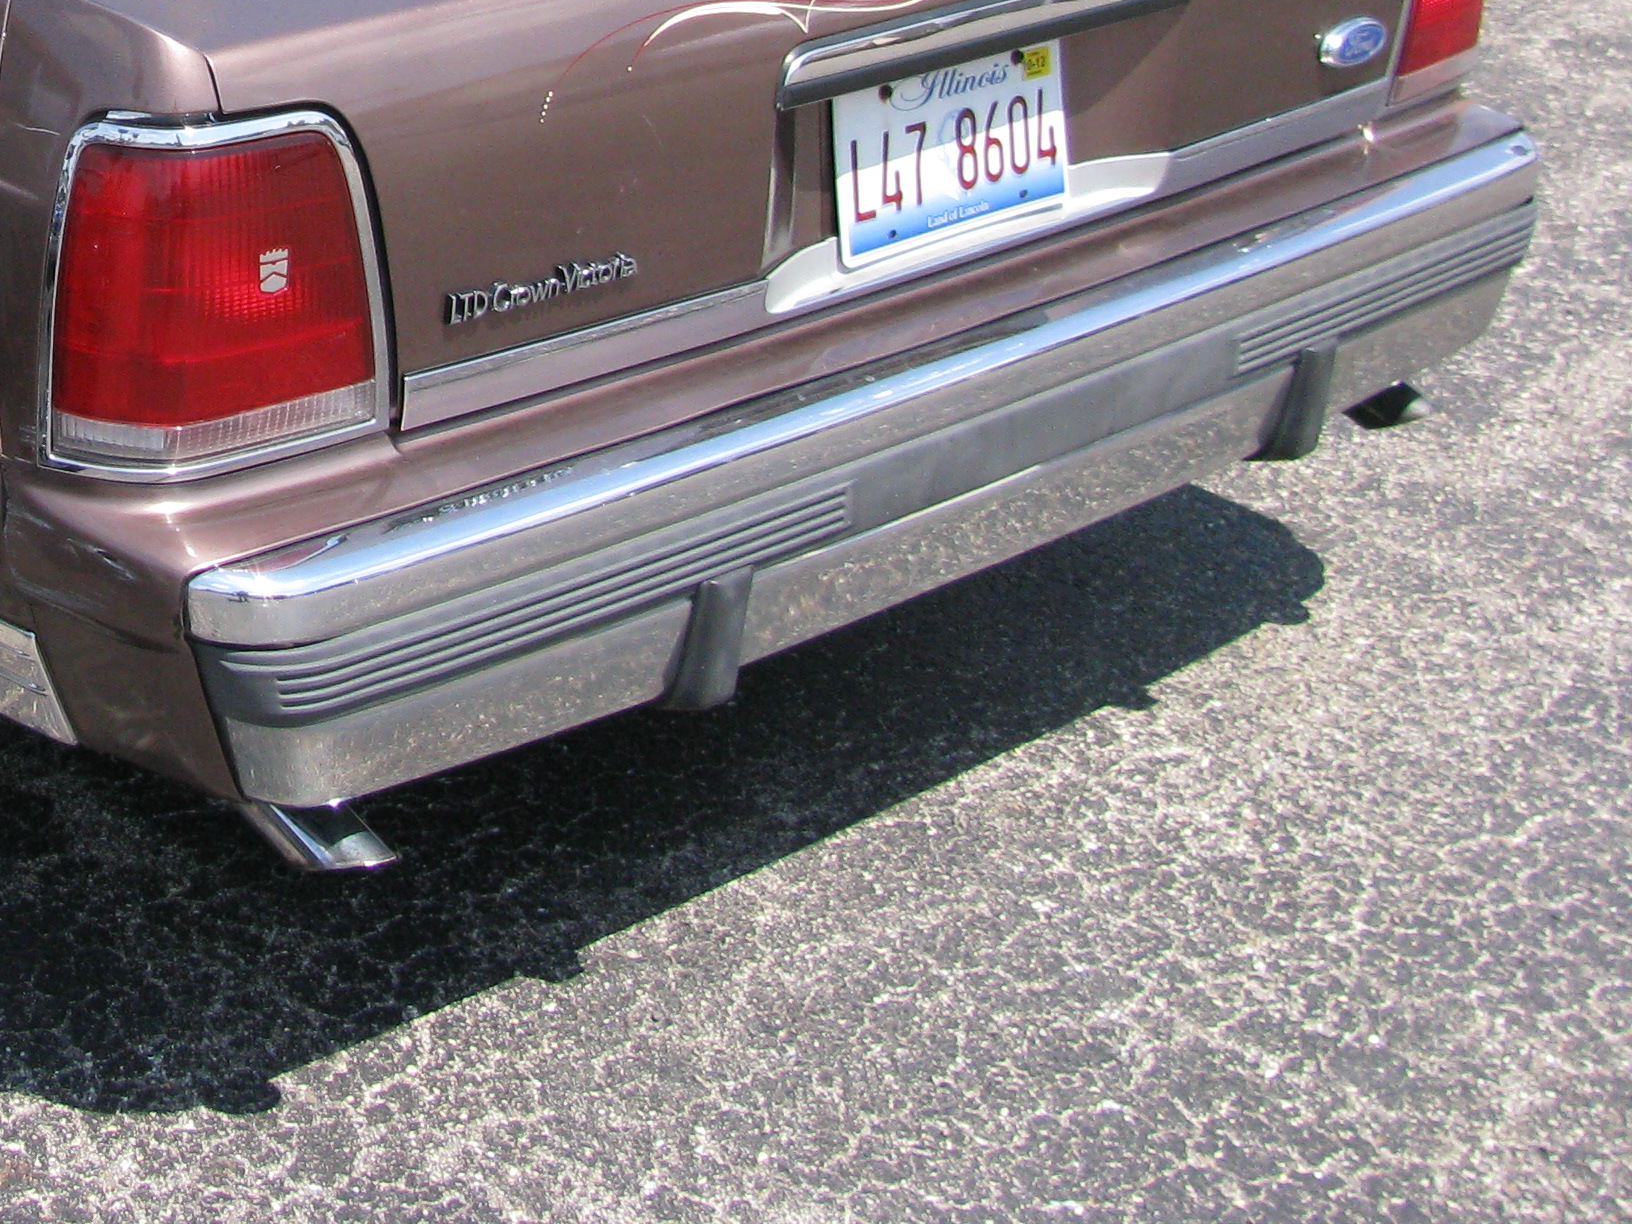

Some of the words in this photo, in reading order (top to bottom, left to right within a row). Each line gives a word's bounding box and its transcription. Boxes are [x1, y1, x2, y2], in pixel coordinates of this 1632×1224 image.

[890, 62, 1010, 112] Illinois
[849, 121, 928, 223] L47
[954, 87, 1058, 191] 8604
[447, 291, 489, 325] LTD
[491, 279, 561, 313] Crown
[557, 251, 638, 293] Victoria
